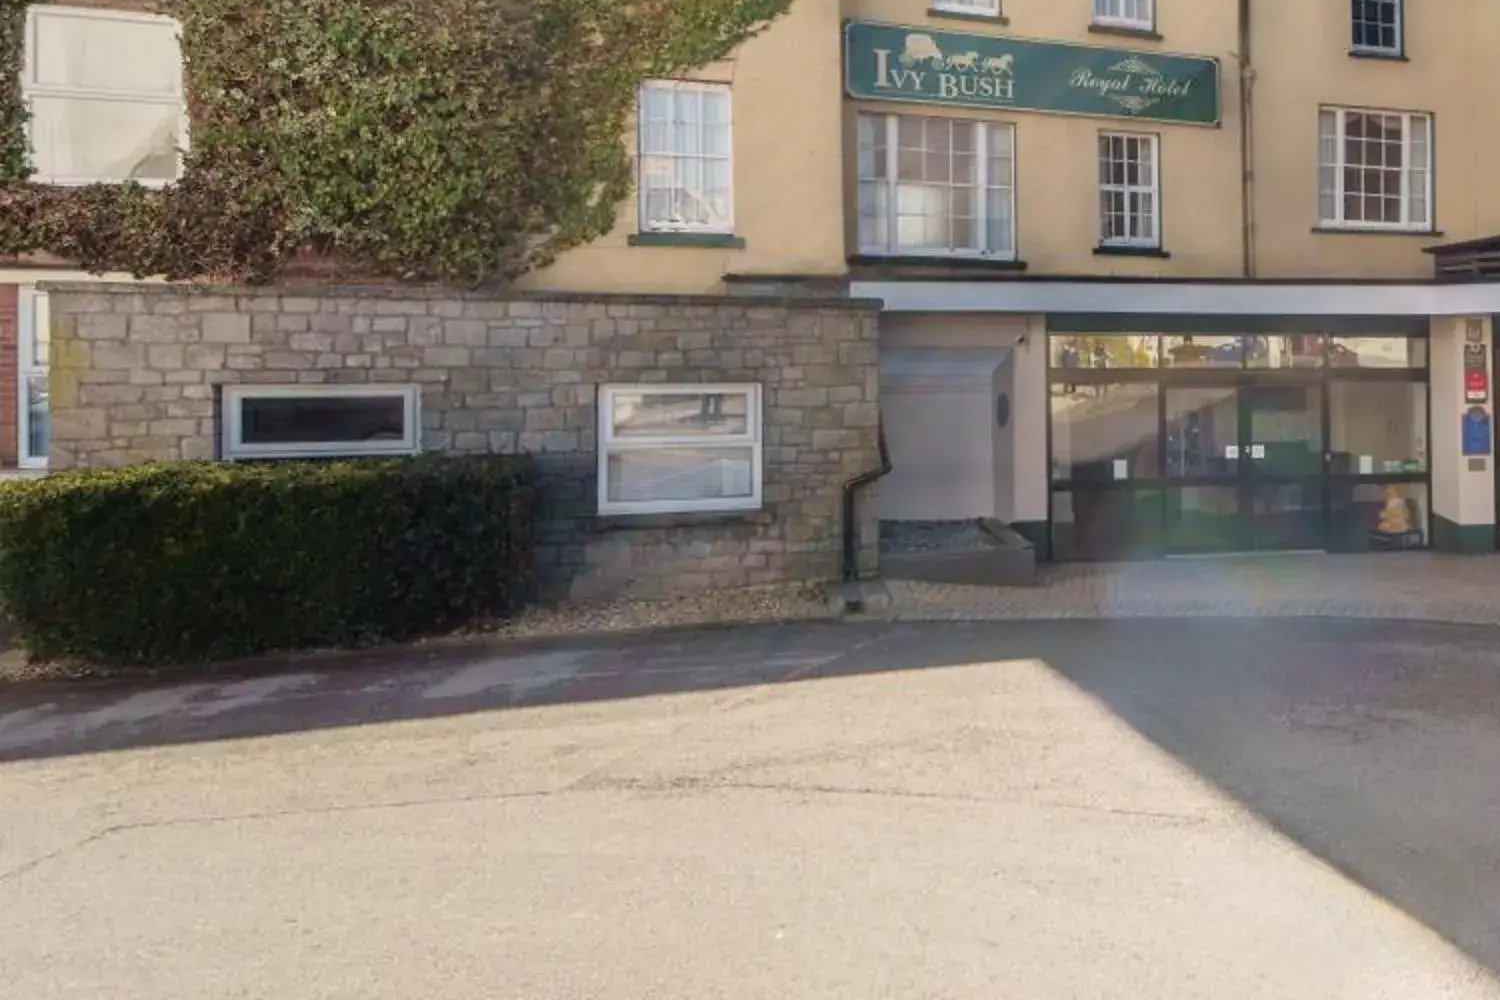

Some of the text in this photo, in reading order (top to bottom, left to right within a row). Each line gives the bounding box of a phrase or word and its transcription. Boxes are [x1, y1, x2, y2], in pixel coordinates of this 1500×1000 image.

[872, 48, 1015, 98] IVY BUSH
[1069, 67, 1191, 96] Royal Hotel
